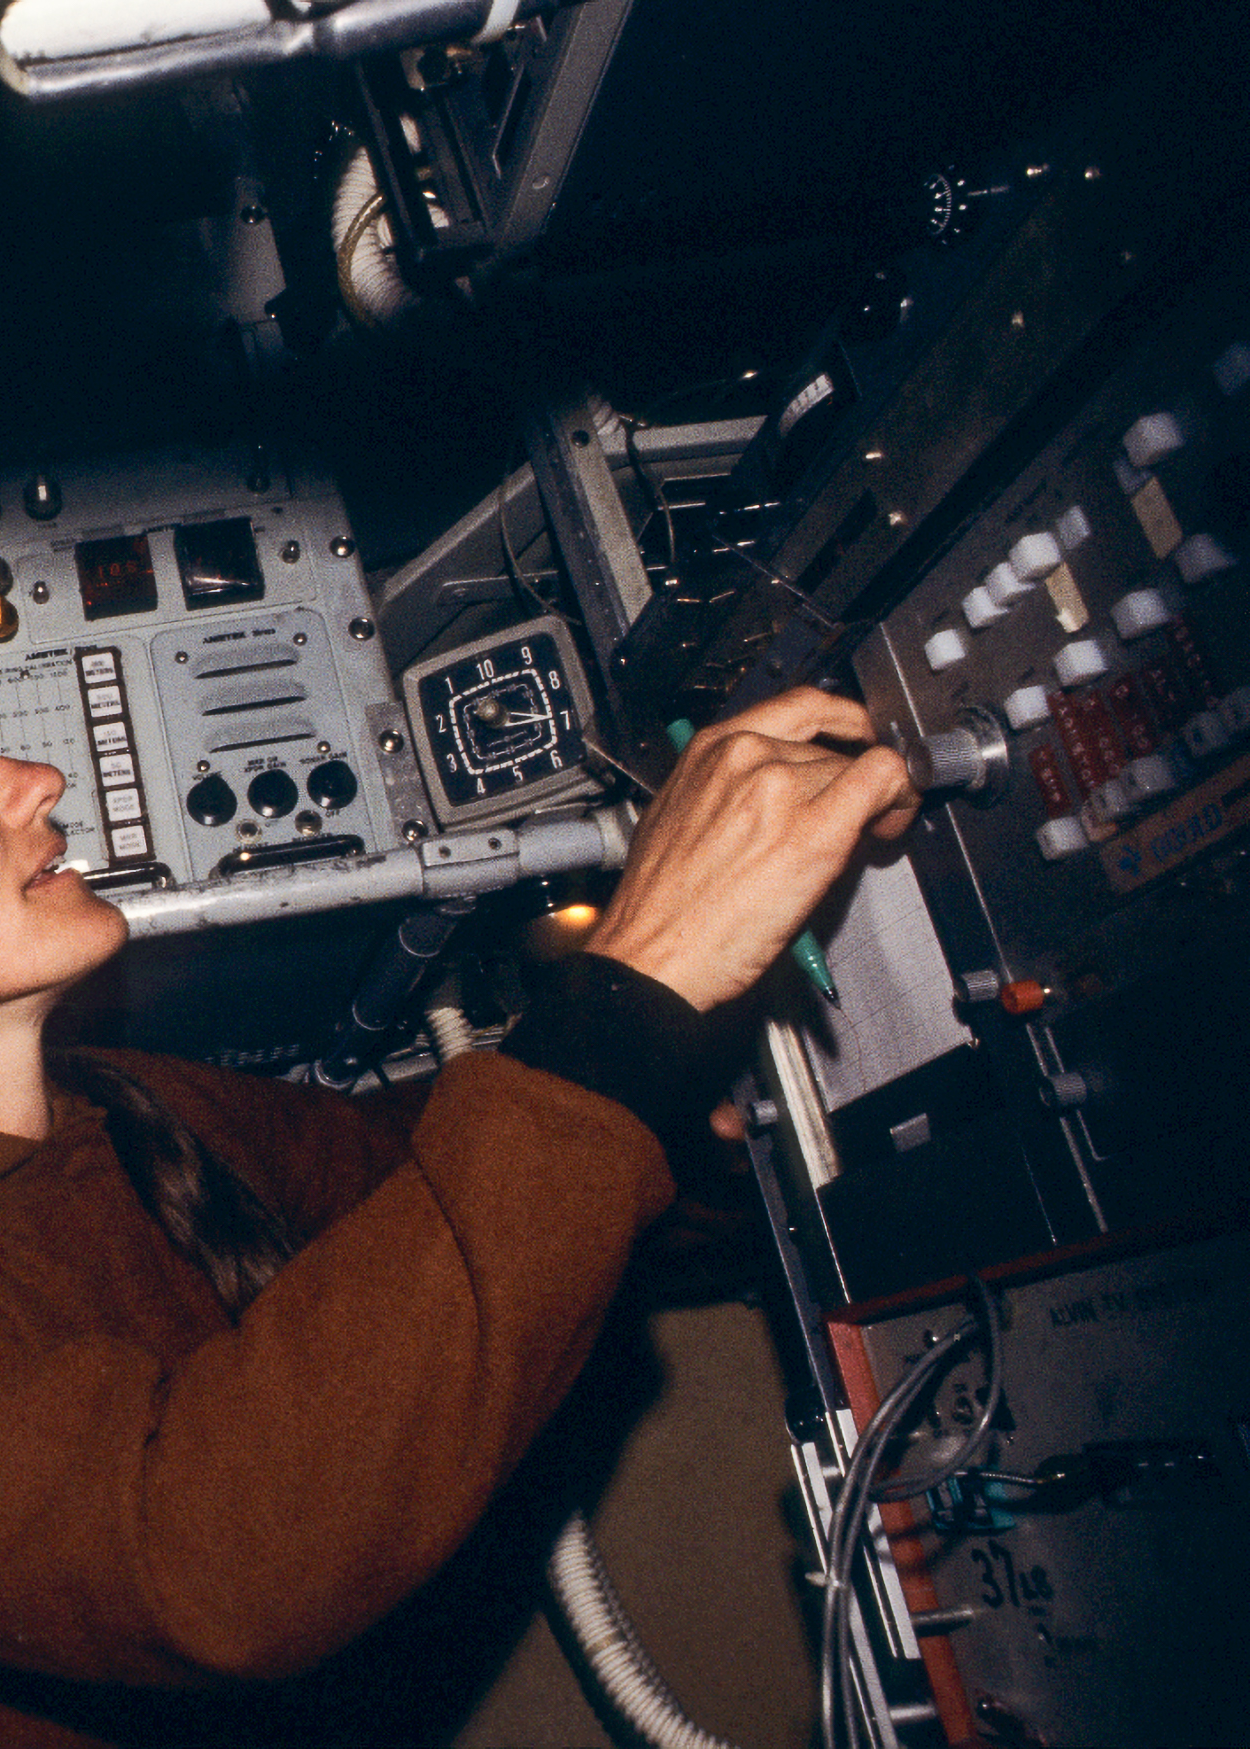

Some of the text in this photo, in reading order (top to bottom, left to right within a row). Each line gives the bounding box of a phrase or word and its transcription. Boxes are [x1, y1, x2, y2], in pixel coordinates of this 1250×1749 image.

[25, 648, 69, 662] AMETEK
[521, 646, 533, 665] 9
[476, 659, 495, 680] 10
[445, 677, 454, 694] 1
[548, 671, 561, 690] 8
[435, 714, 447, 733] 2
[559, 710, 571, 730] 7
[446, 753, 457, 773] 3
[550, 750, 563, 769] 6
[512, 766, 524, 782] 5
[476, 777, 486, 794] 4
